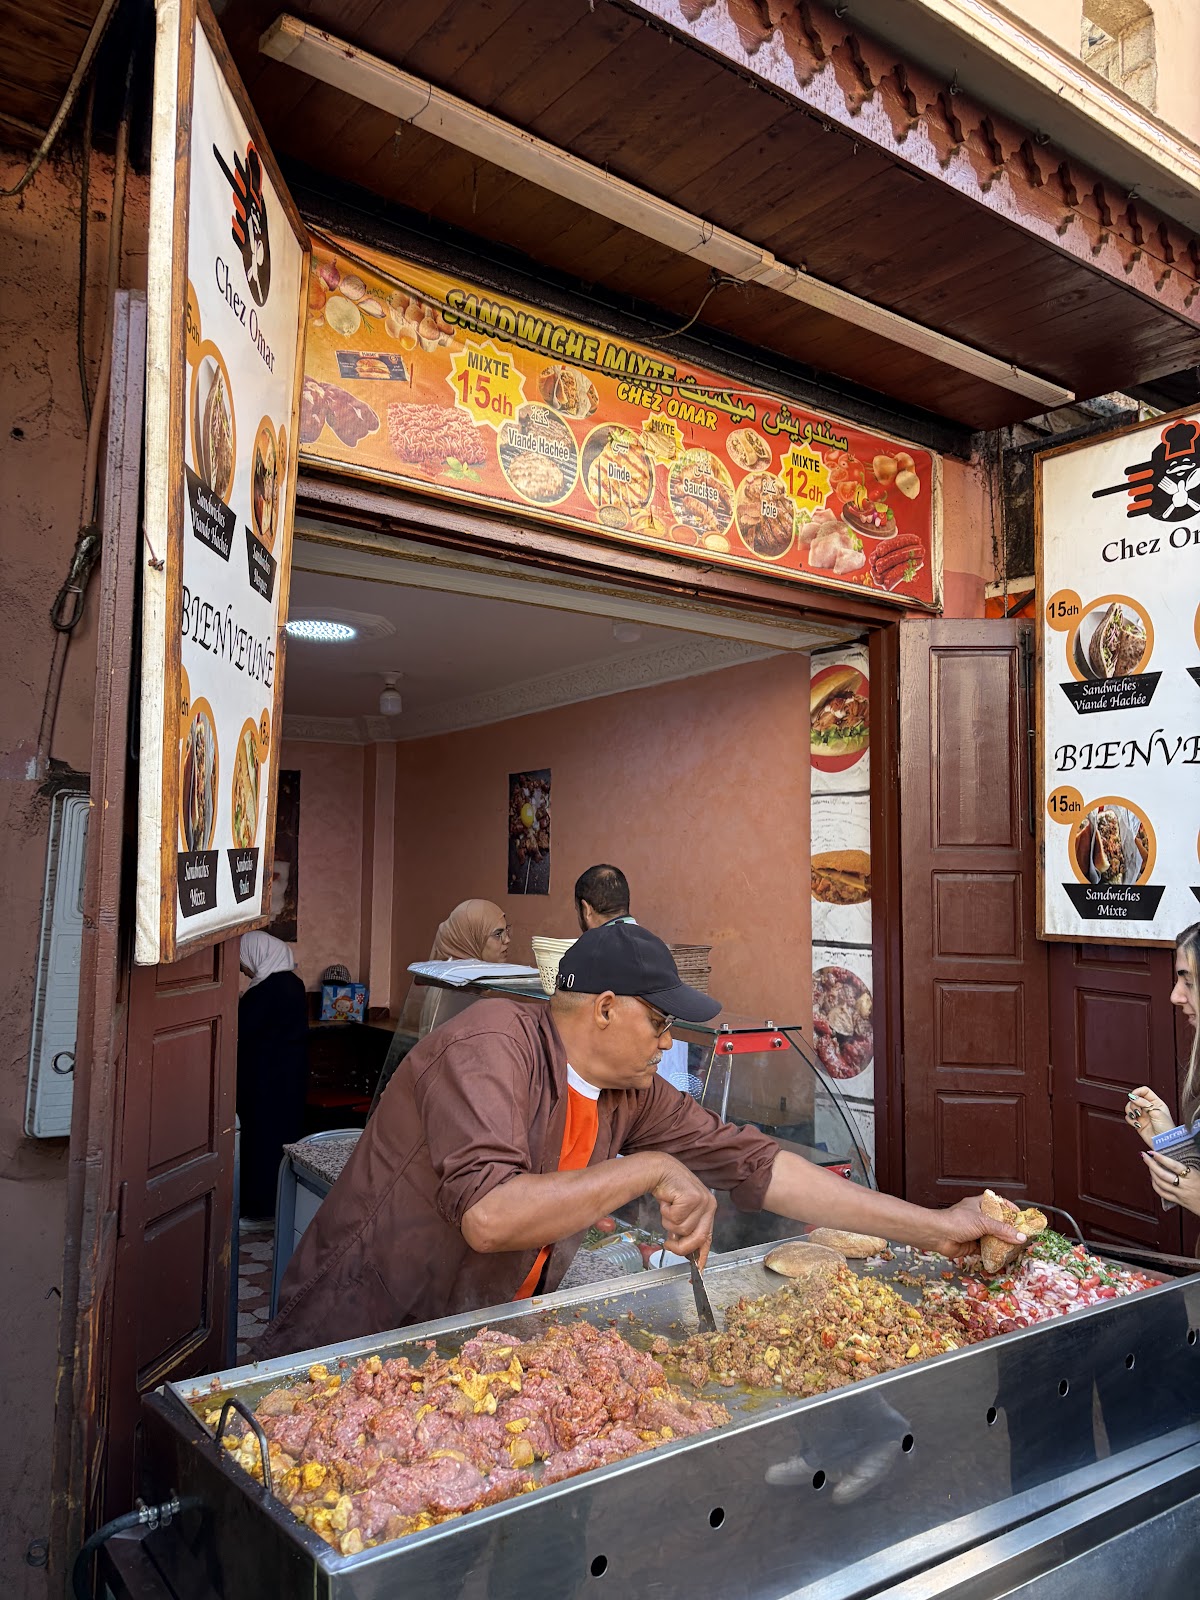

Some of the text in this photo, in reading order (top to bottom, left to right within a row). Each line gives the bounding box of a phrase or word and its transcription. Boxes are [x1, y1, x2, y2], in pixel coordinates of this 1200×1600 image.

[186, 302, 200, 347] 5dh
[215, 256, 275, 374] Chez Omar
[443, 289, 677, 396] SANDWICHE MIXTE
[468, 351, 510, 379] MIXTE
[457, 369, 513, 416] 15dh
[616, 382, 719, 431] CHEZ OMAR
[652, 419, 676, 436] MIXTE
[762, 404, 849, 451] سندويش
[508, 428, 569, 459] Viande Hachée
[608, 462, 631, 482] Dinde
[791, 453, 820, 473] MIXTE
[684, 479, 718, 500] Saucisse
[785, 467, 823, 503] 12dh
[196, 487, 226, 528] Sandwiches
[762, 500, 777, 517] Foie
[192, 508, 210, 540] Viande
[1101, 537, 1161, 563] Chez
[1048, 601, 1079, 618] 15dh
[1083, 678, 1137, 696] Sandwiches
[1074, 691, 1147, 710] Viande Hachée
[1055, 729, 1200, 771] BIENVE
[1050, 795, 1081, 812] 15dh
[190, 888, 206, 907] Mixte
[1085, 887, 1141, 902] Sandwiches
[1097, 903, 1127, 917] Mixte
